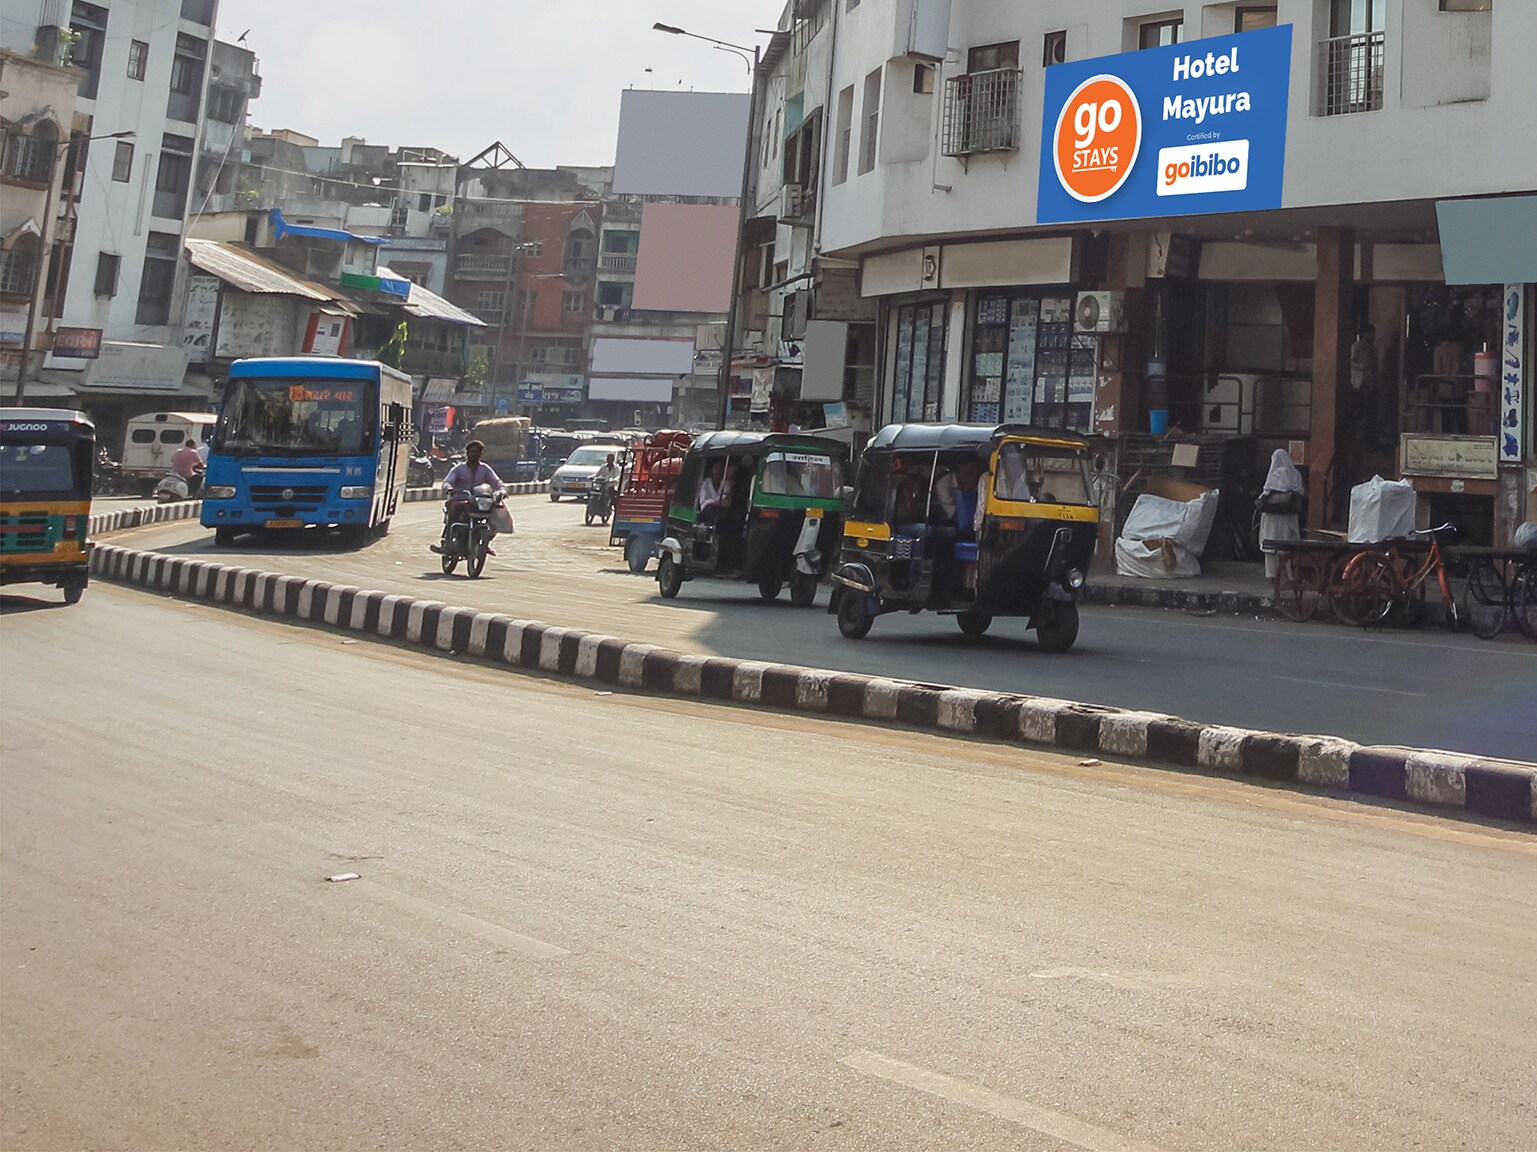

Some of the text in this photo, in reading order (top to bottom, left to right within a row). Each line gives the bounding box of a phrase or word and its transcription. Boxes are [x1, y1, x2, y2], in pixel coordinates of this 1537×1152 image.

[1172, 46, 1240, 81] Hotel
[1162, 91, 1251, 124] Mayura
[1073, 99, 1122, 149] go
[1186, 131, 1221, 141] Certified by
[1073, 146, 1119, 168] STAYS
[1165, 153, 1240, 186] goibibo
[499, 399, 506, 408] P
[8, 423, 48, 431] JUGNOO
